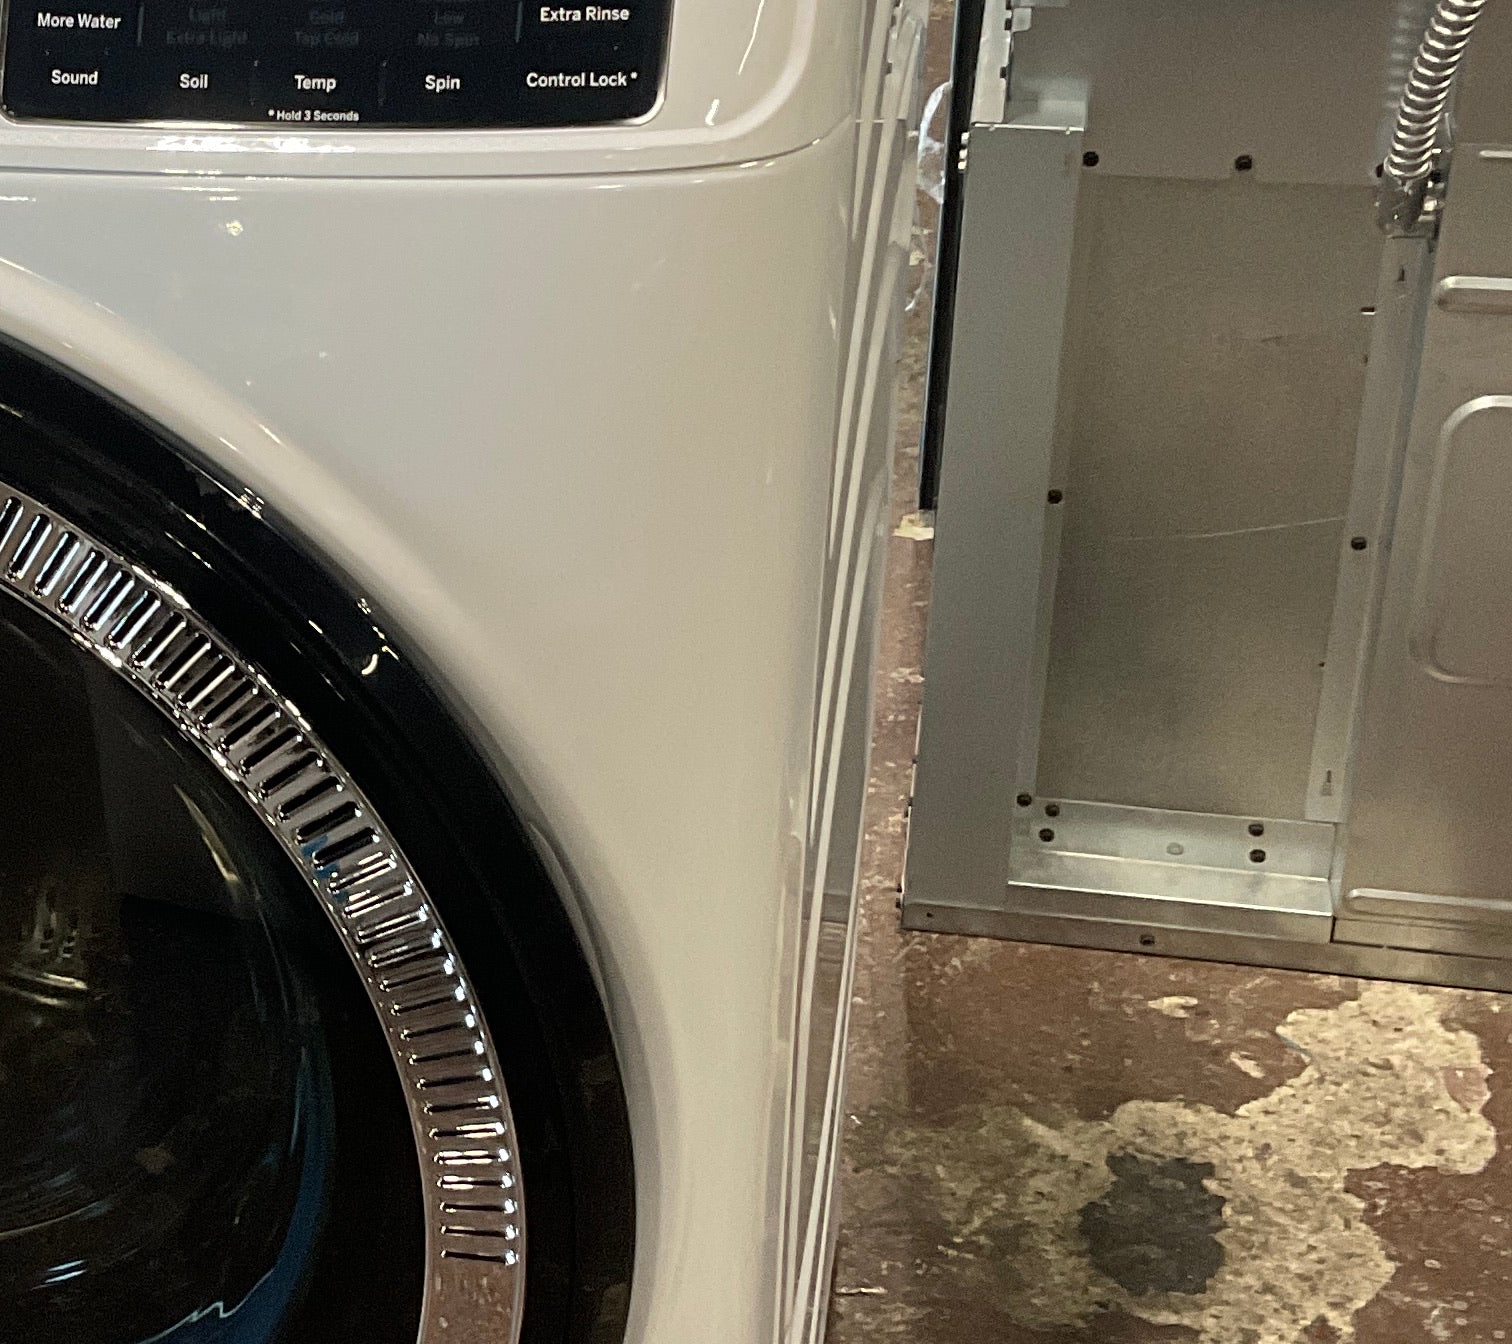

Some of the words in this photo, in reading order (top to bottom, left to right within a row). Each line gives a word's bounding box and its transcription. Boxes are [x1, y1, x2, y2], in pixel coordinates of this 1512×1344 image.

[37, 12, 74, 28] More
[77, 13, 122, 30] Water
[540, 6, 582, 22] Extra
[585, 6, 630, 21] Rinse
[51, 69, 99, 85] Sound
[179, 73, 209, 89] Soil
[294, 74, 337, 93] Temp
[425, 74, 460, 93] Spin
[526, 71, 585, 88] Control
[589, 71, 628, 87] Lock
[276, 109, 302, 122] Hold
[304, 110, 311, 122] 3
[313, 109, 360, 122] Seconds
